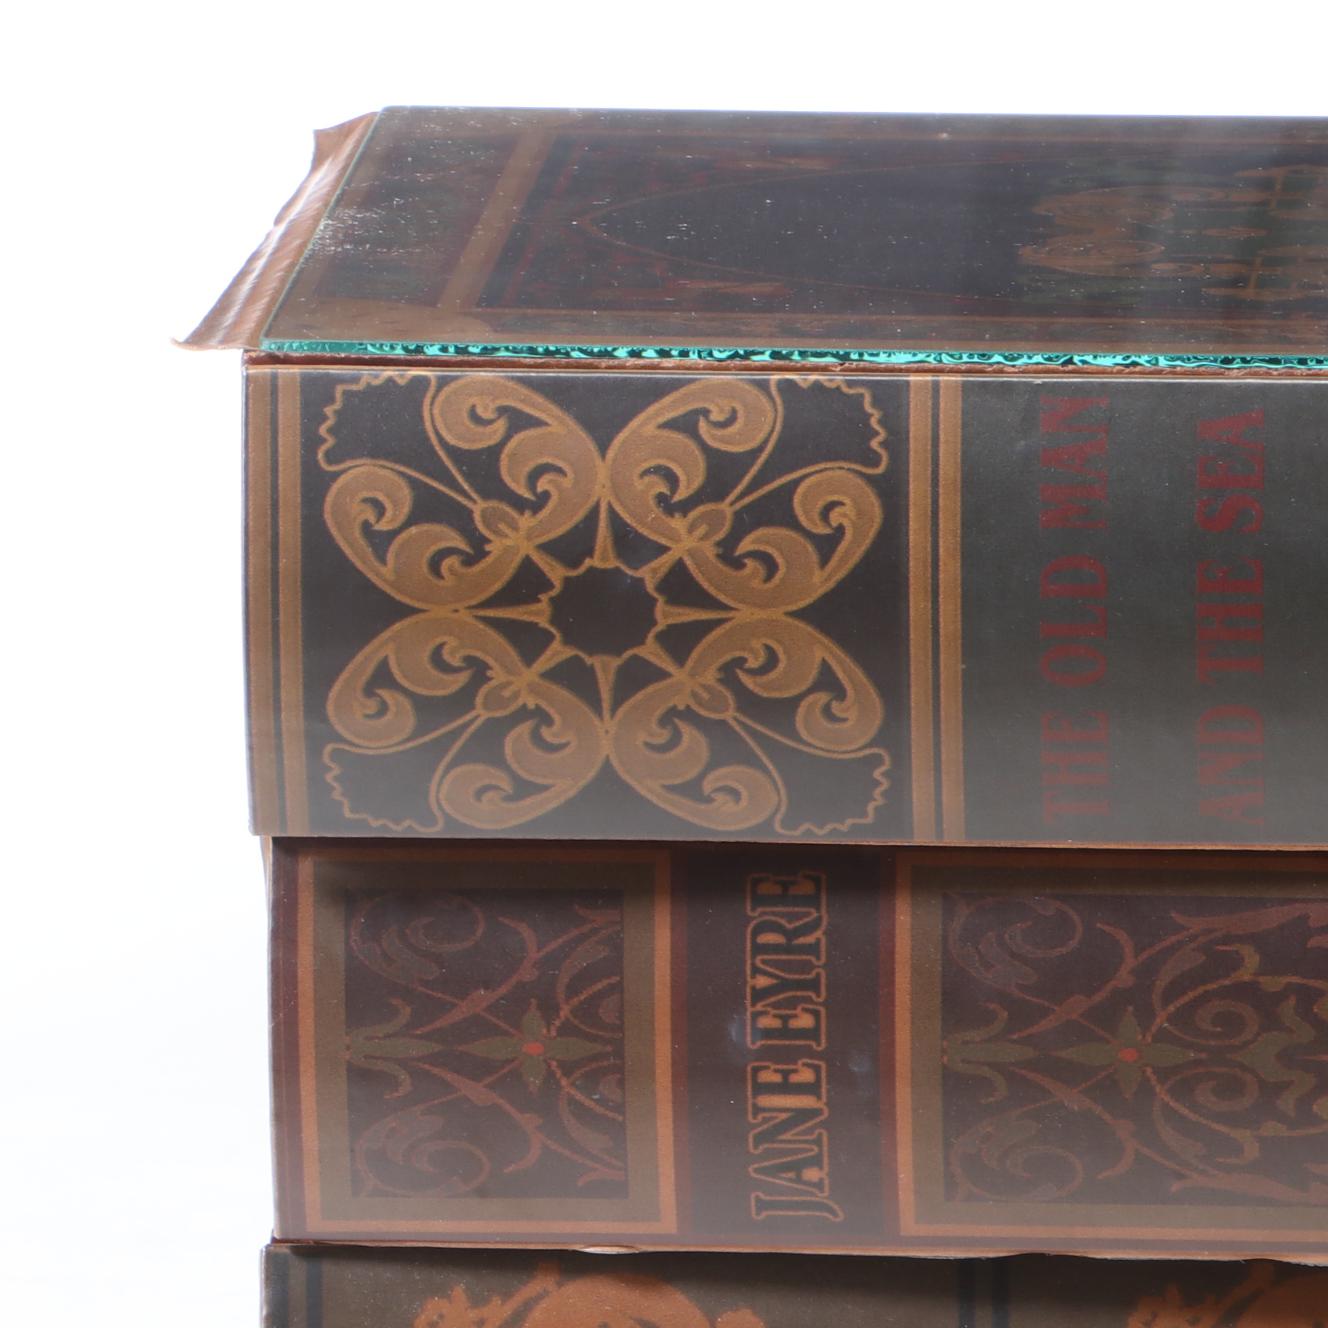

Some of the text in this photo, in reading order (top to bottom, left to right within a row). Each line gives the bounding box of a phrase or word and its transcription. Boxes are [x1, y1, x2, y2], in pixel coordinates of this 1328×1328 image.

[1038, 394, 1109, 824] THE OLD MAN
[1196, 406, 1265, 826] AND THE SEA
[746, 870, 844, 1222] JANE EYRE
